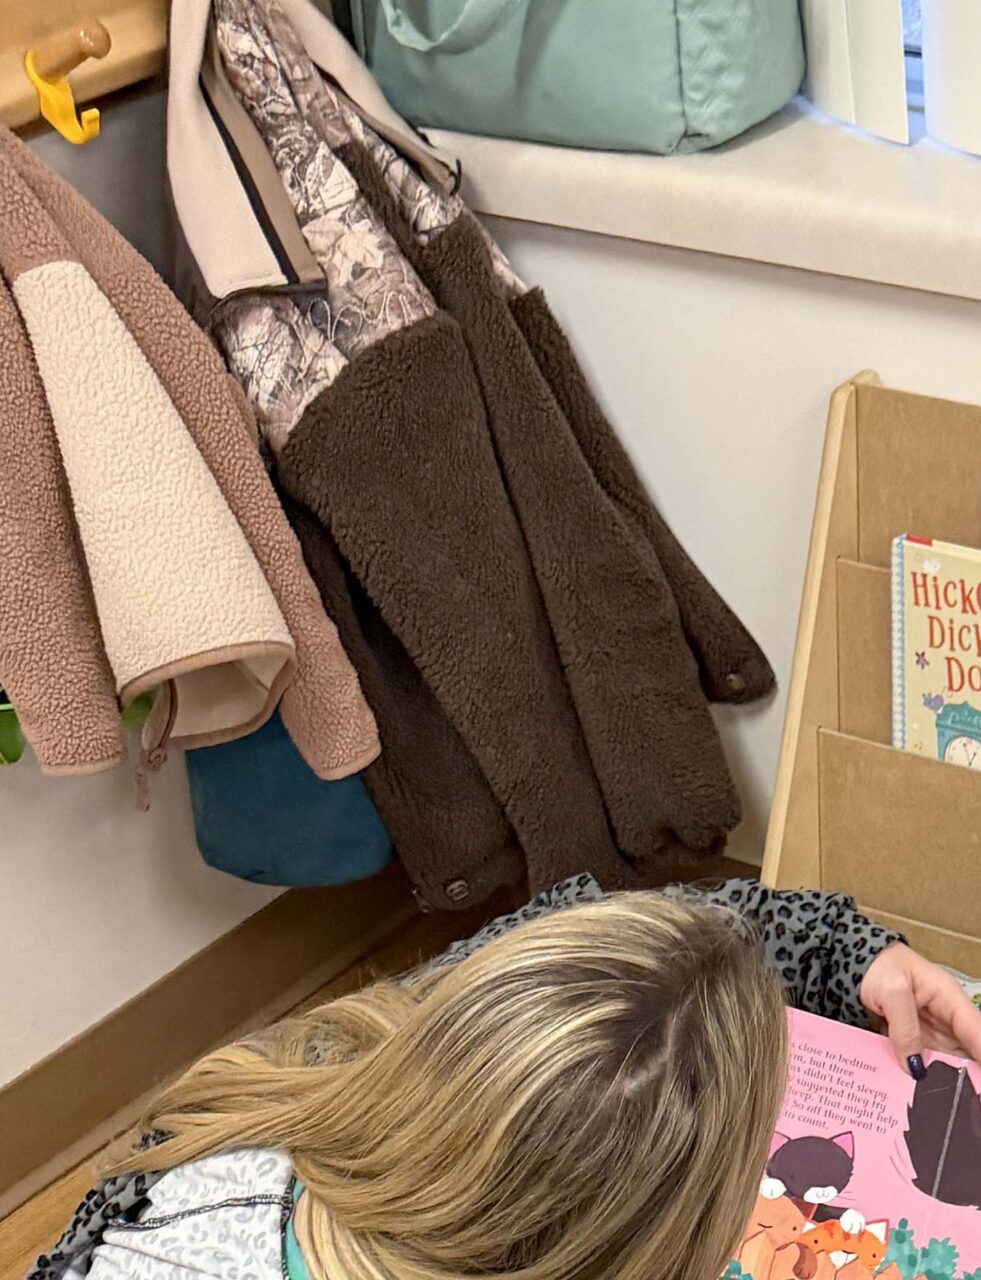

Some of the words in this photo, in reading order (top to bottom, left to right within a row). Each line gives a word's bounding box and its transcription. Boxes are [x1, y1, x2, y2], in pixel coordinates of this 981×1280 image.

[798, 1043, 823, 1056] close
[825, 1051, 836, 1060] to
[838, 1053, 878, 1073] bedtime
[809, 1056, 825, 1069] but
[829, 1063, 855, 1077] three
[804, 1067, 834, 1083] didn't
[836, 1077, 855, 1089] feel
[797, 1078, 845, 1098] suggested
[847, 1092, 869, 1107] they
[872, 1099, 886, 1114] try
[806, 1105, 822, 1116] off
[824, 1109, 846, 1125] they
[849, 1118, 873, 1130] went
[876, 1125, 887, 1134] to
[818, 1094, 841, 1109] That
[844, 1104, 874, 1120] might
[877, 1111, 899, 1129] help
